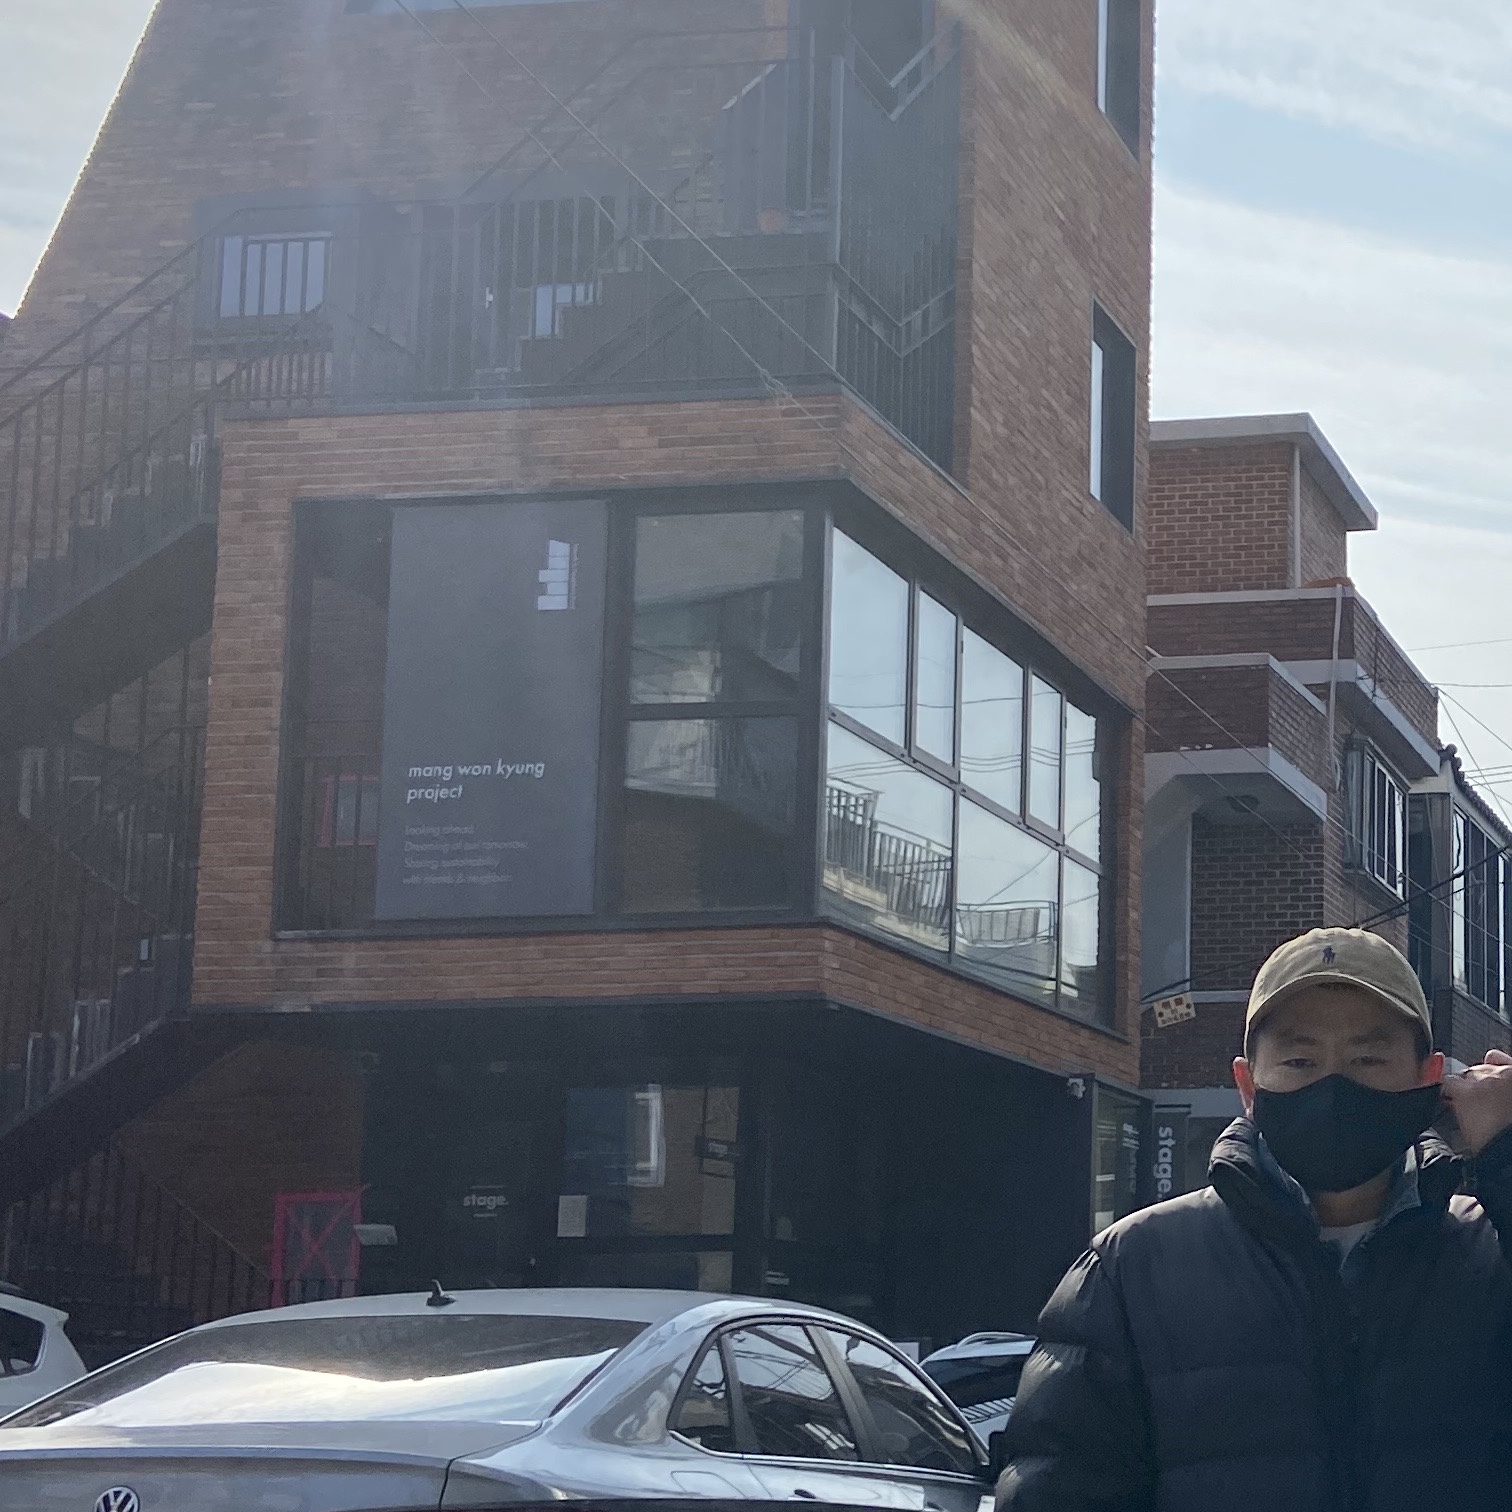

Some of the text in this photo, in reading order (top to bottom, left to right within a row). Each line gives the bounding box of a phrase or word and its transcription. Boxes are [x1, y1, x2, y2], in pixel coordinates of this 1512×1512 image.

[408, 757, 546, 781] mang won kyung
[405, 783, 465, 805] project
